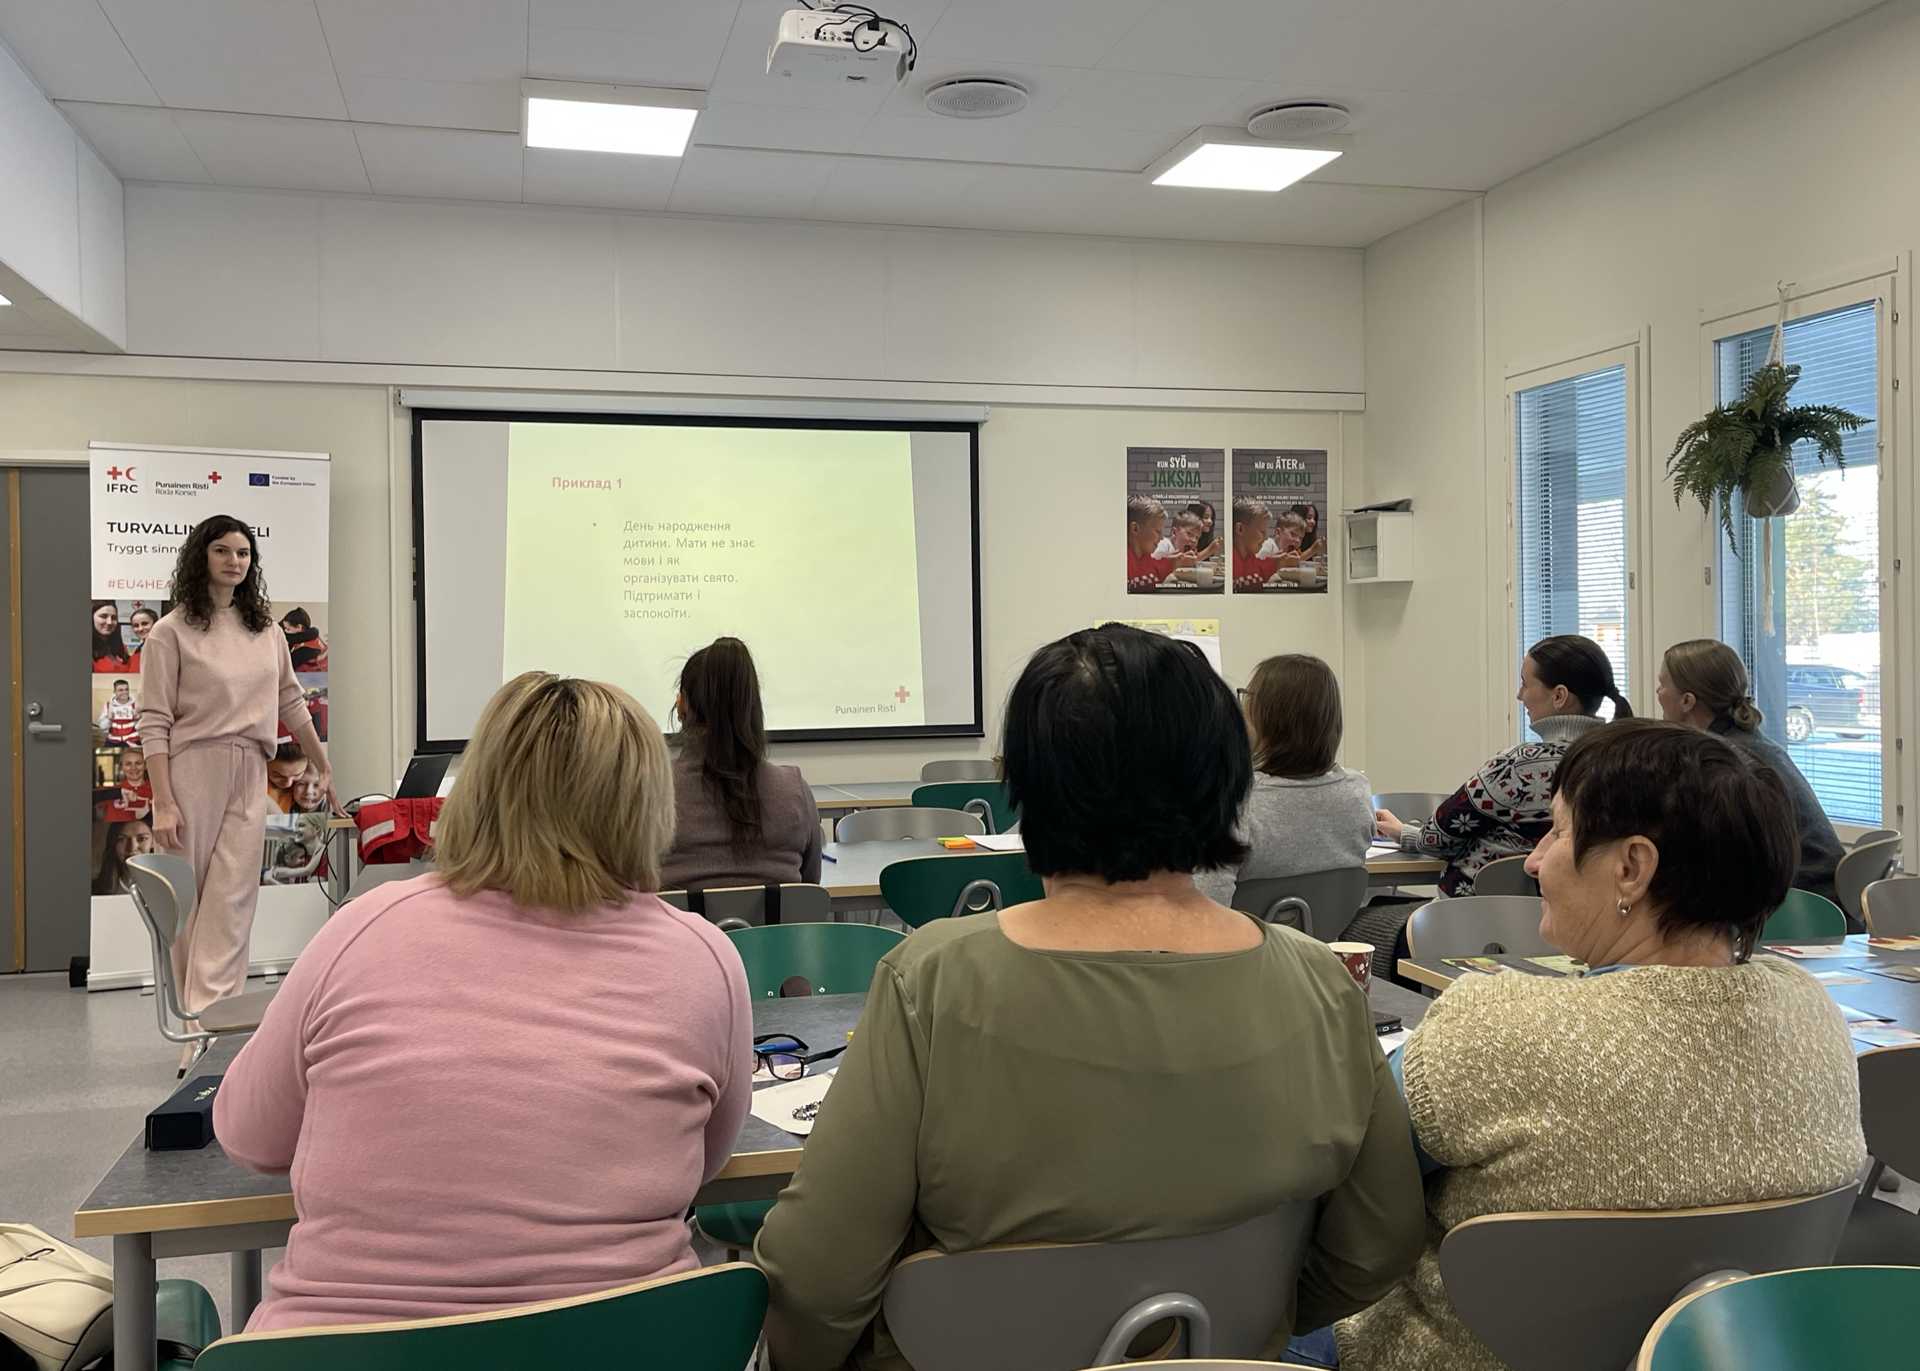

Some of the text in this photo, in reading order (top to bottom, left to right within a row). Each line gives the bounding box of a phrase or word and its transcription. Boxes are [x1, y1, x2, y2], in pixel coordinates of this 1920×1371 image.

[1157, 460, 1168, 468] KUN
[1169, 455, 1187, 469] SYÖ
[1275, 456, 1298, 470] ÄTER
[552, 477, 622, 490] Приклад 1
[1151, 469, 1202, 488] JAKSAA
[1249, 470, 1311, 487] ORKAR DU
[107, 483, 138, 493] IFRC
[155, 481, 209, 490] Punainen Risti
[623, 520, 731, 534] День народження
[107, 543, 148, 555] Tryggt
[623, 538, 755, 550] дитини. Мати не знає
[623, 555, 680, 566] мови і як
[623, 573, 738, 586] організувати свято.
[623, 589, 701, 603] Підтримати і
[623, 608, 691, 619] заспокоїти.
[835, 703, 897, 714] Punainen Risti
